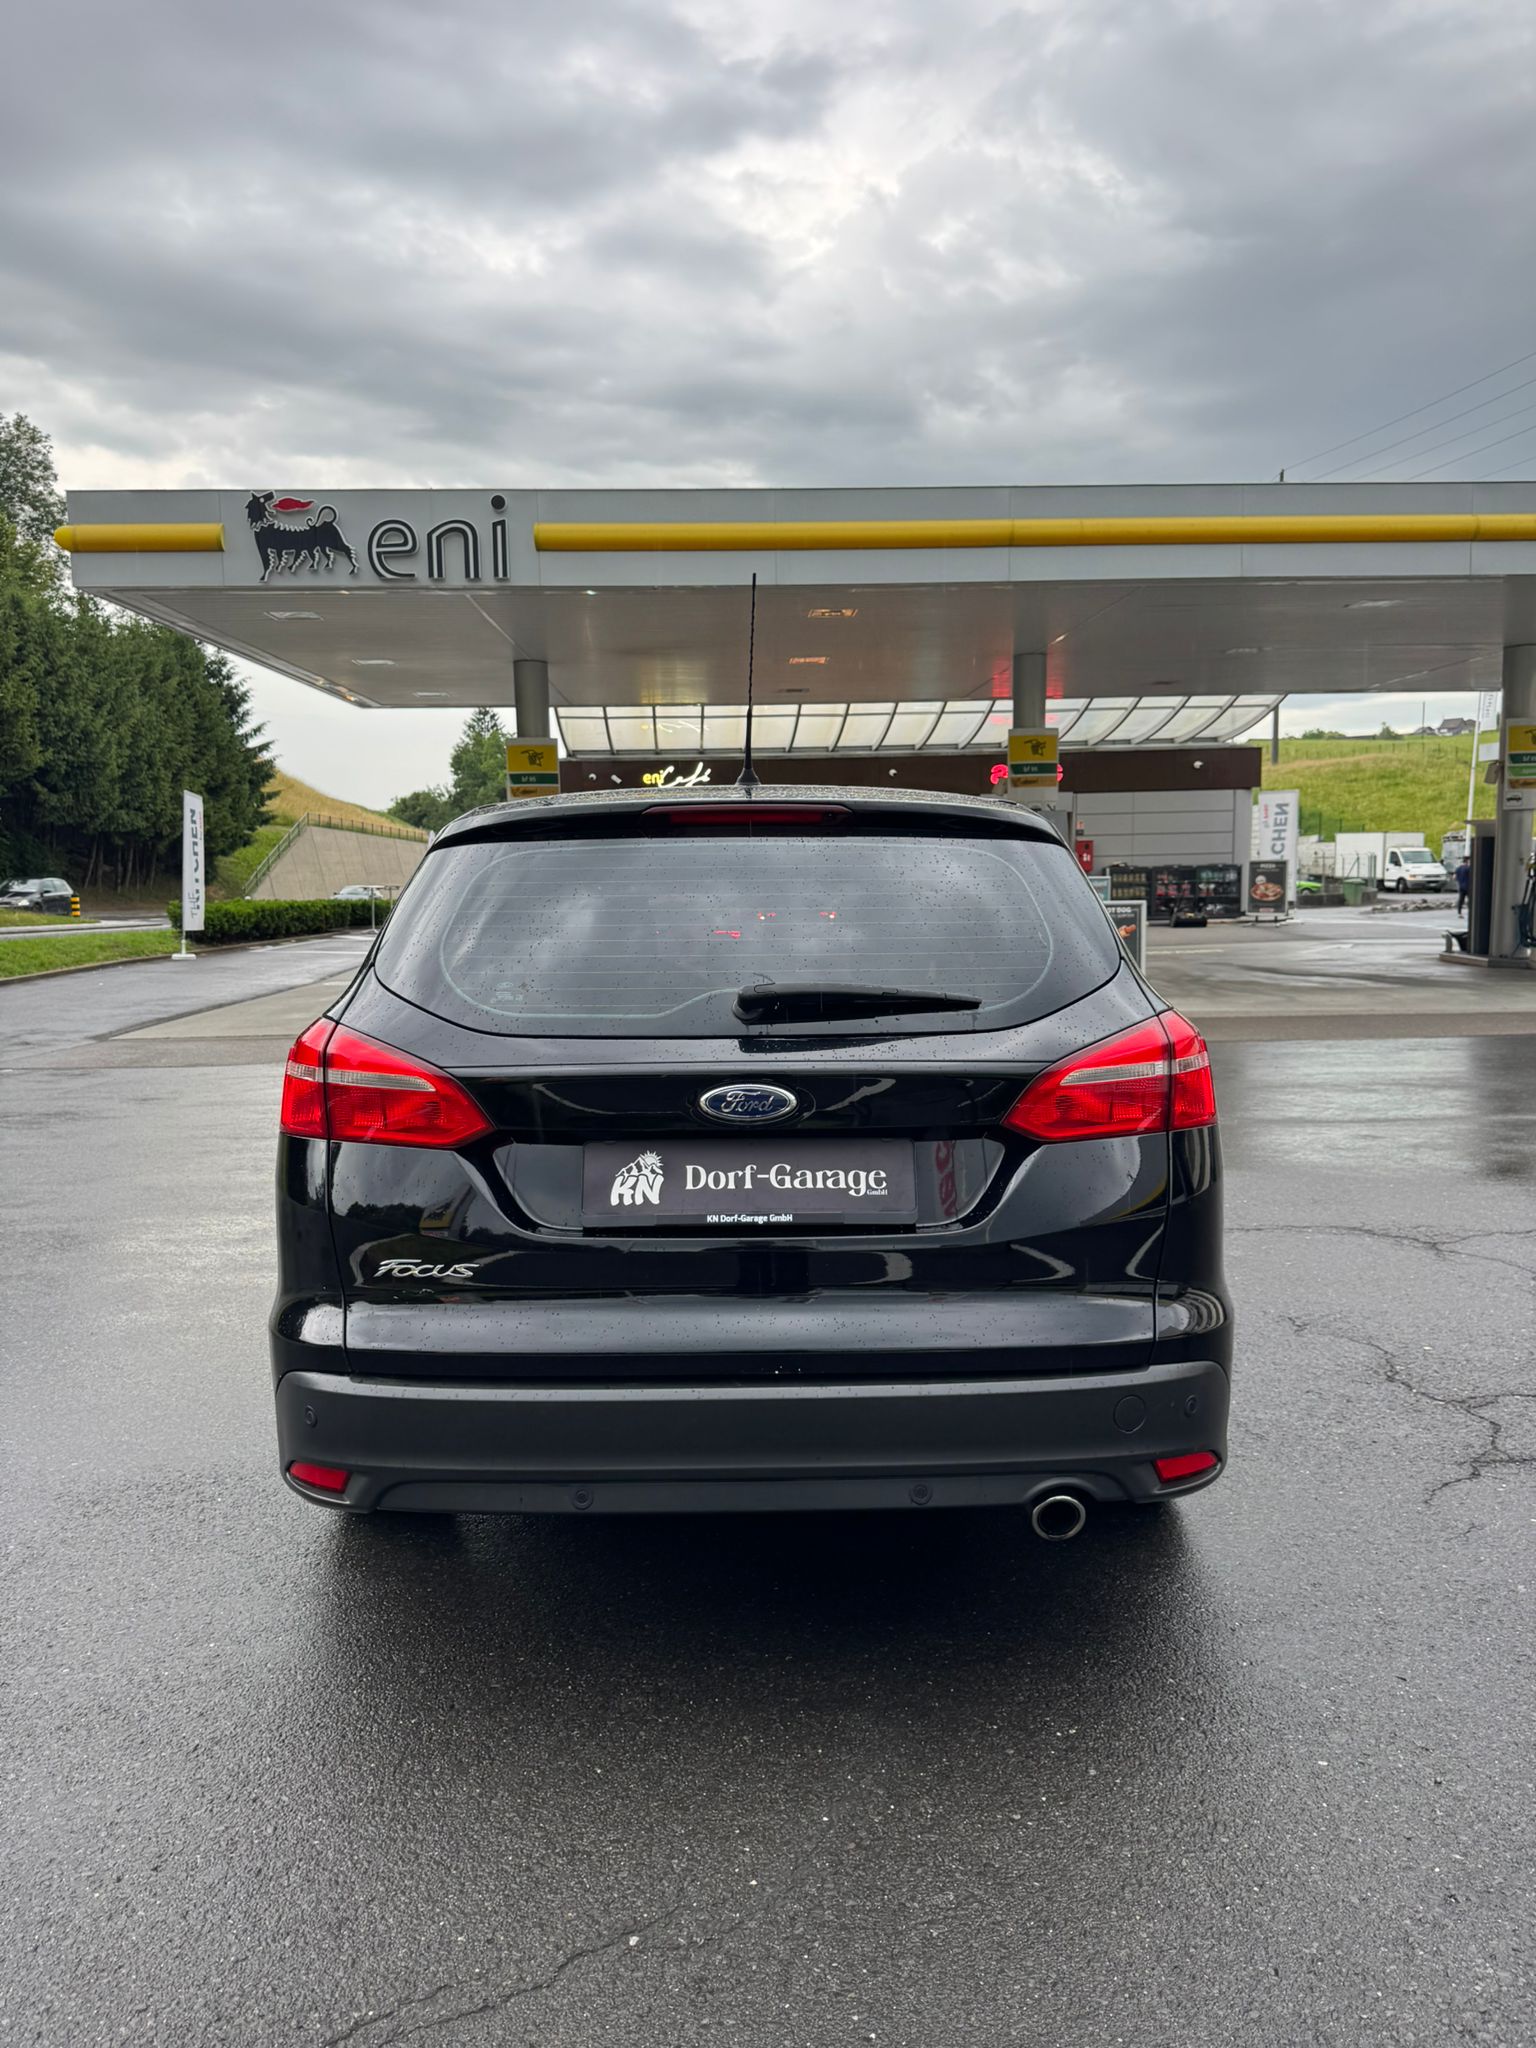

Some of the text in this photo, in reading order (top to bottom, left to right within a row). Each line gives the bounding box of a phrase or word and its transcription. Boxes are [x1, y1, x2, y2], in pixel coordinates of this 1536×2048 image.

[367, 494, 509, 579] eni
[642, 769, 664, 785] eni
[721, 1091, 775, 1113] Ford
[610, 1174, 665, 1206] KN
[685, 1163, 888, 1197] Dorf-Garage
[706, 1213, 793, 1224] KN Dorf-Garage GmbH
